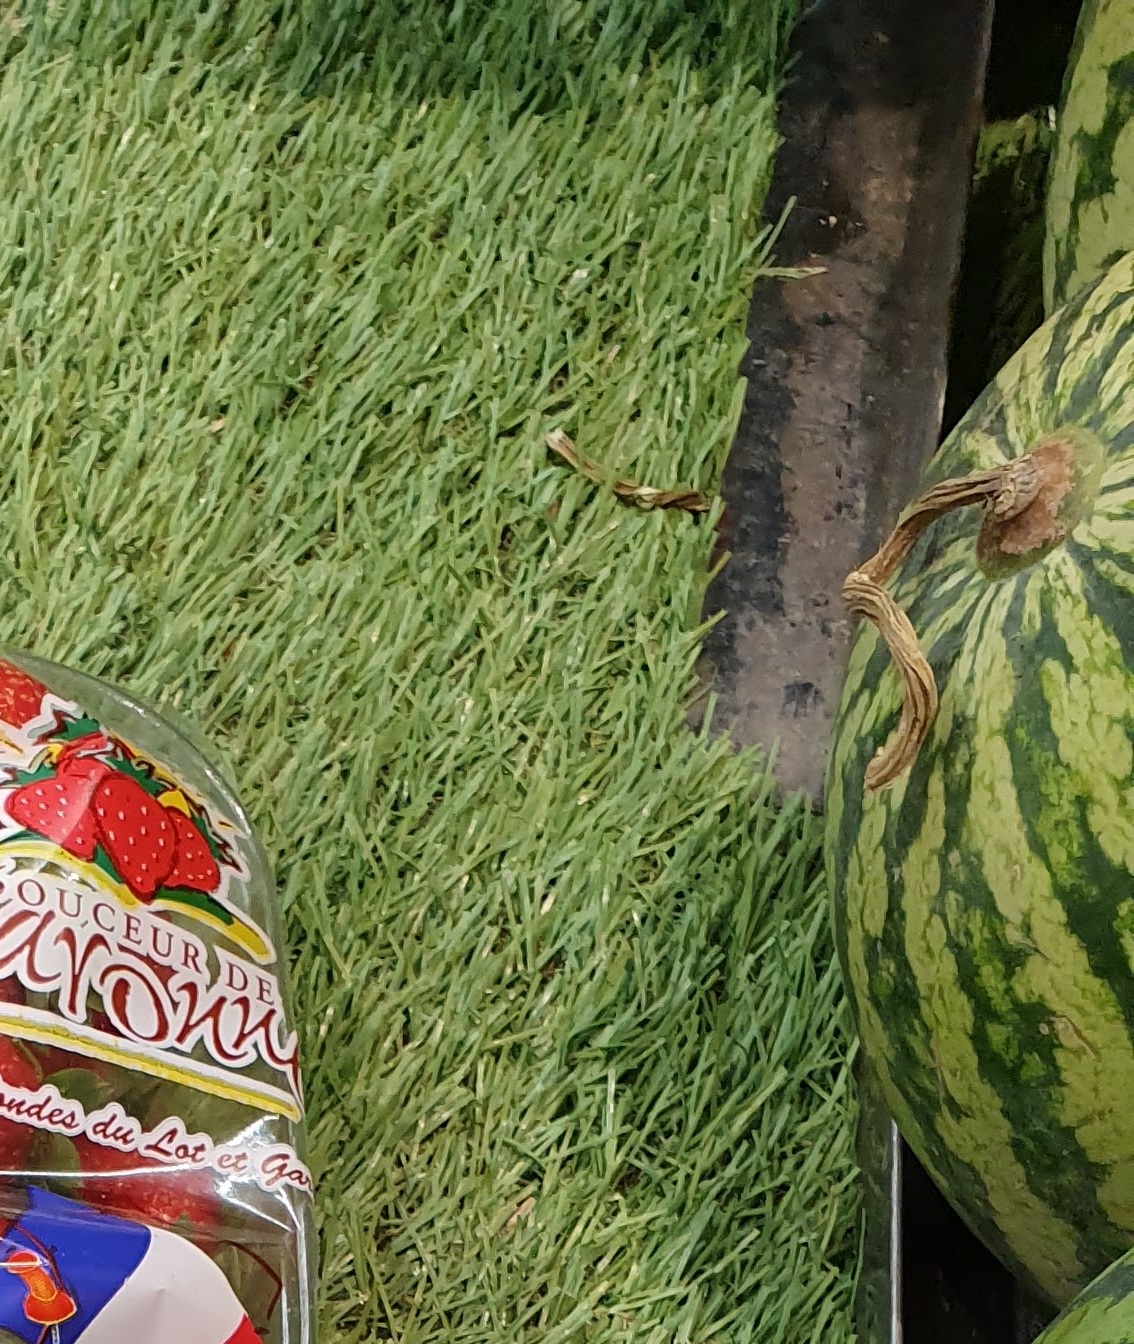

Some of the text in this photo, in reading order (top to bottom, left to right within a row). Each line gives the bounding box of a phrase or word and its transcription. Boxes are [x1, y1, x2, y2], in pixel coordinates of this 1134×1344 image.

[225, 961, 275, 1005] DE
[90, 1114, 135, 1148] du
[148, 1130, 205, 1164] Lot
[217, 1151, 249, 1172] et
